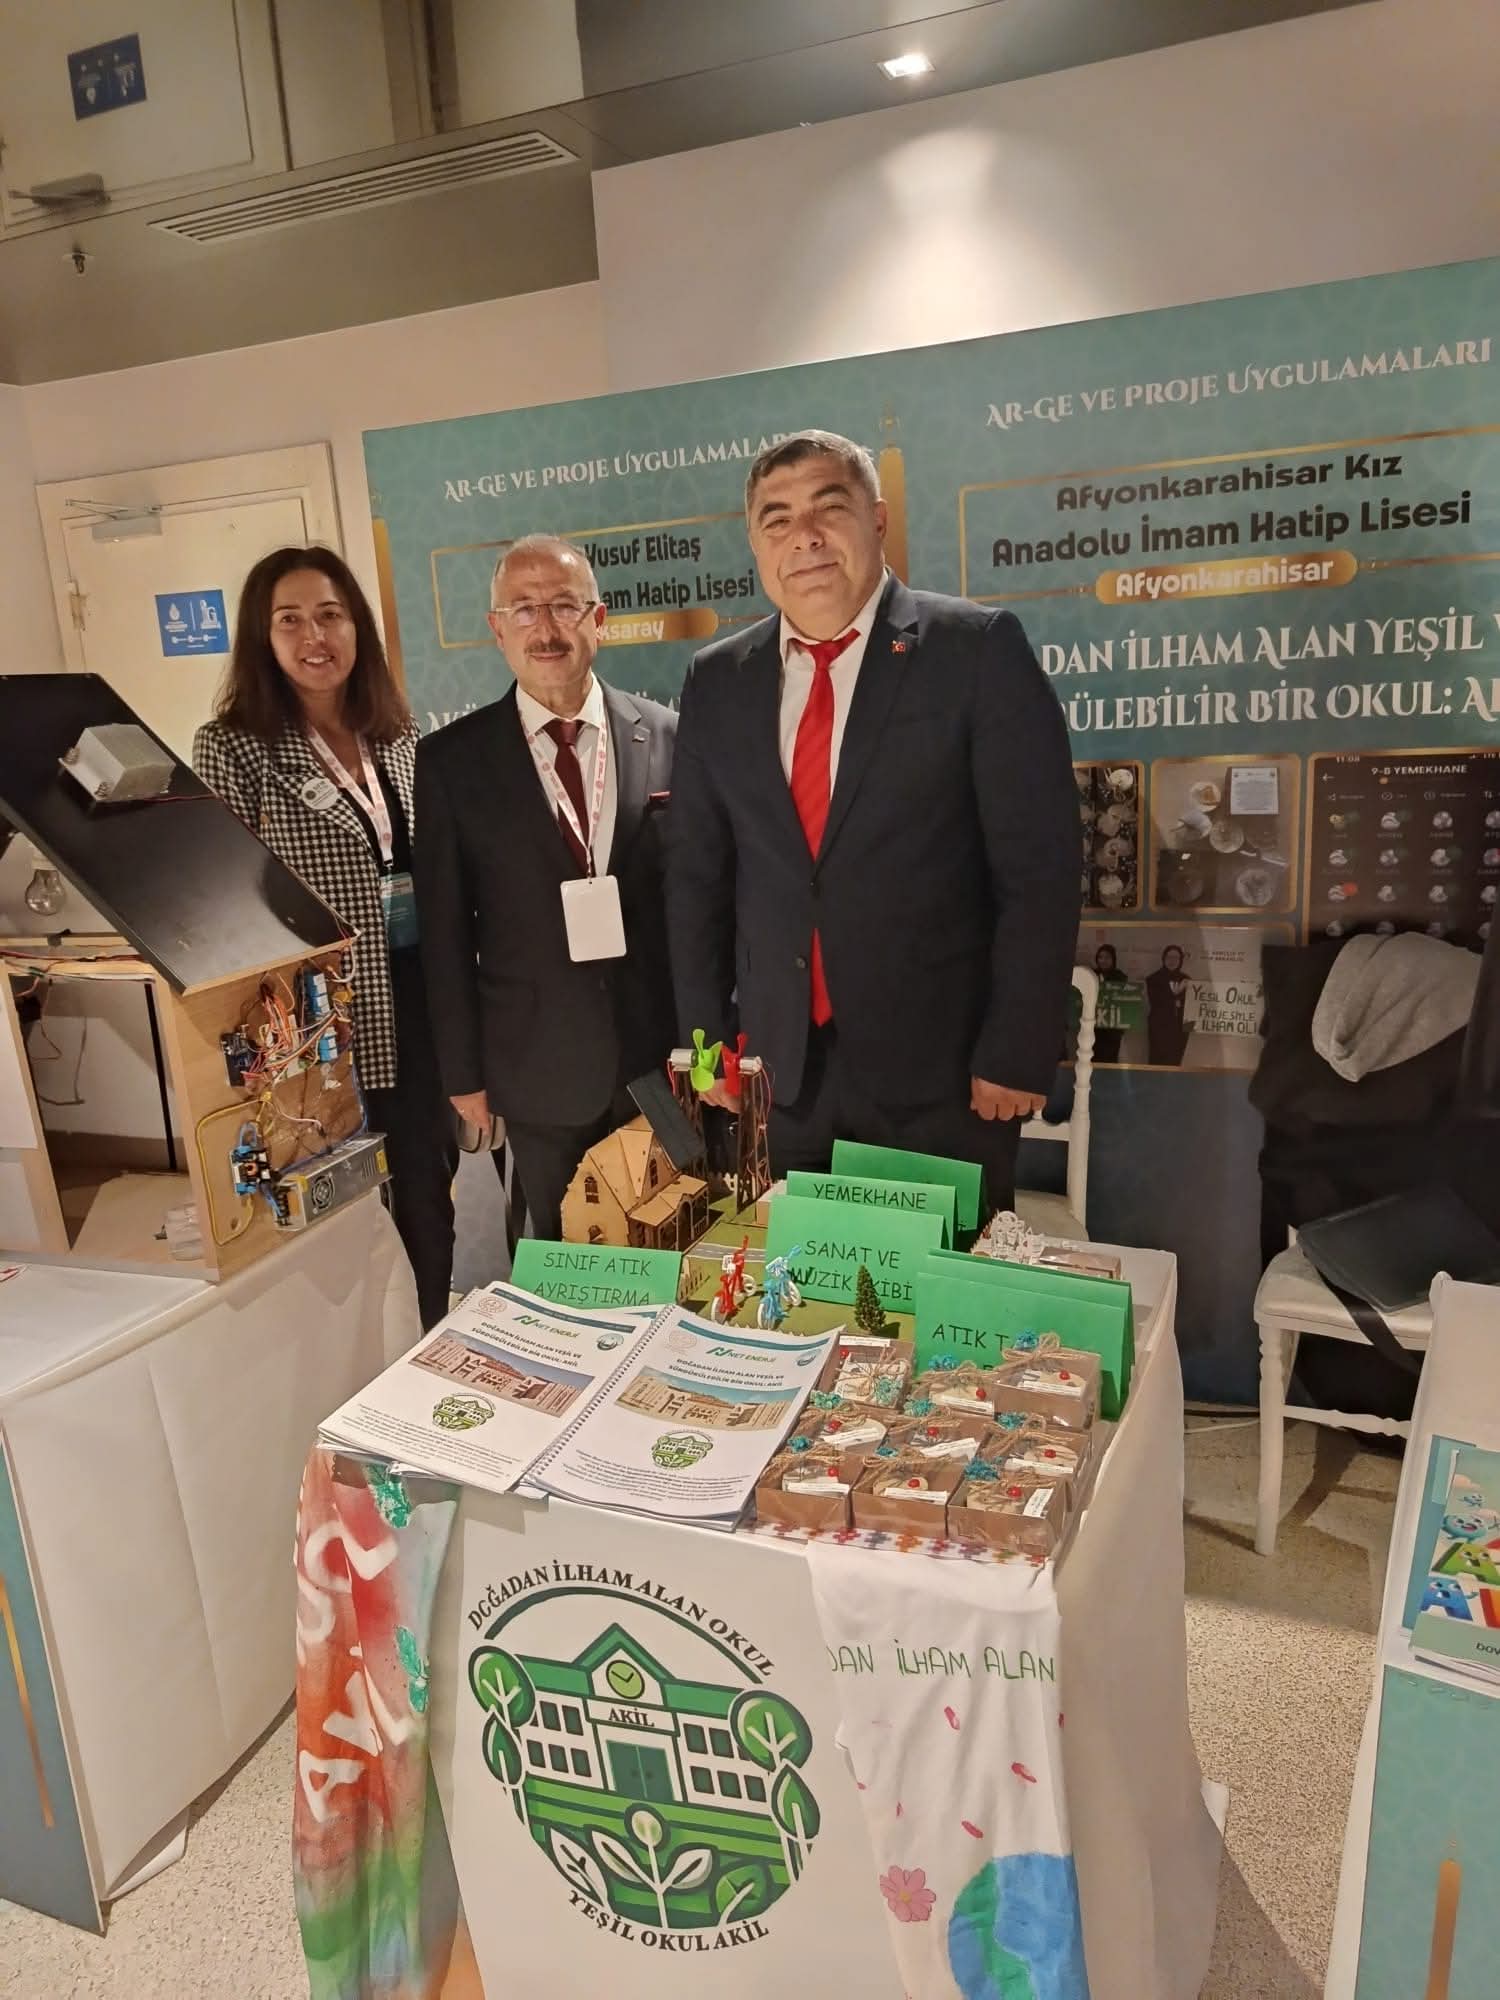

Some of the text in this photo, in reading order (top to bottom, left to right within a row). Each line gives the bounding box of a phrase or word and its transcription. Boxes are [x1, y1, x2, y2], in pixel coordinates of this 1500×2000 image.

[986, 337, 1492, 429] AR-GE VE PROJE UYGULAMALARI
[445, 474, 507, 502] AR-GE
[510, 470, 537, 489] VE
[542, 459, 609, 486] PROJE
[1057, 453, 1402, 511] Afyonkarahisar Kız
[646, 533, 701, 561] Elitaş
[992, 490, 1471, 568] Anadolu İmam Hatip Lisesi
[637, 577, 691, 608] Hatip
[696, 568, 755, 601] Lisesi
[1116, 558, 1334, 599] Afyonkarahisar
[1121, 629, 1245, 670] İLHAM
[1253, 622, 1357, 670] ALAN
[1364, 606, 1484, 662] YEŞİL
[1060, 684, 1240, 732] ÜLEBİLİR
[1246, 679, 1319, 722] BİR
[1326, 680, 1453, 719] OKUL:
[1393, 764, 1468, 775] YEMEKHANE
[813, 1183, 928, 1209] YEMEKHANE
[543, 1252, 651, 1276] SINIF ATIK
[804, 1240, 901, 1269] SANAT VE
[534, 1281, 650, 1306] AYRIŞTIRMA
[932, 1323, 987, 1349] ATIK
[552, 1559, 633, 1589] İLHAM
[635, 1579, 708, 1621] ALAN
[708, 1618, 775, 1676] OKUL
[894, 1638, 972, 1678] İLHAM
[984, 1645, 1056, 1682] ALAN
[608, 1707, 655, 1727] AKİL
[568, 1890, 769, 1951] YEŞİL OKUL AKİL
